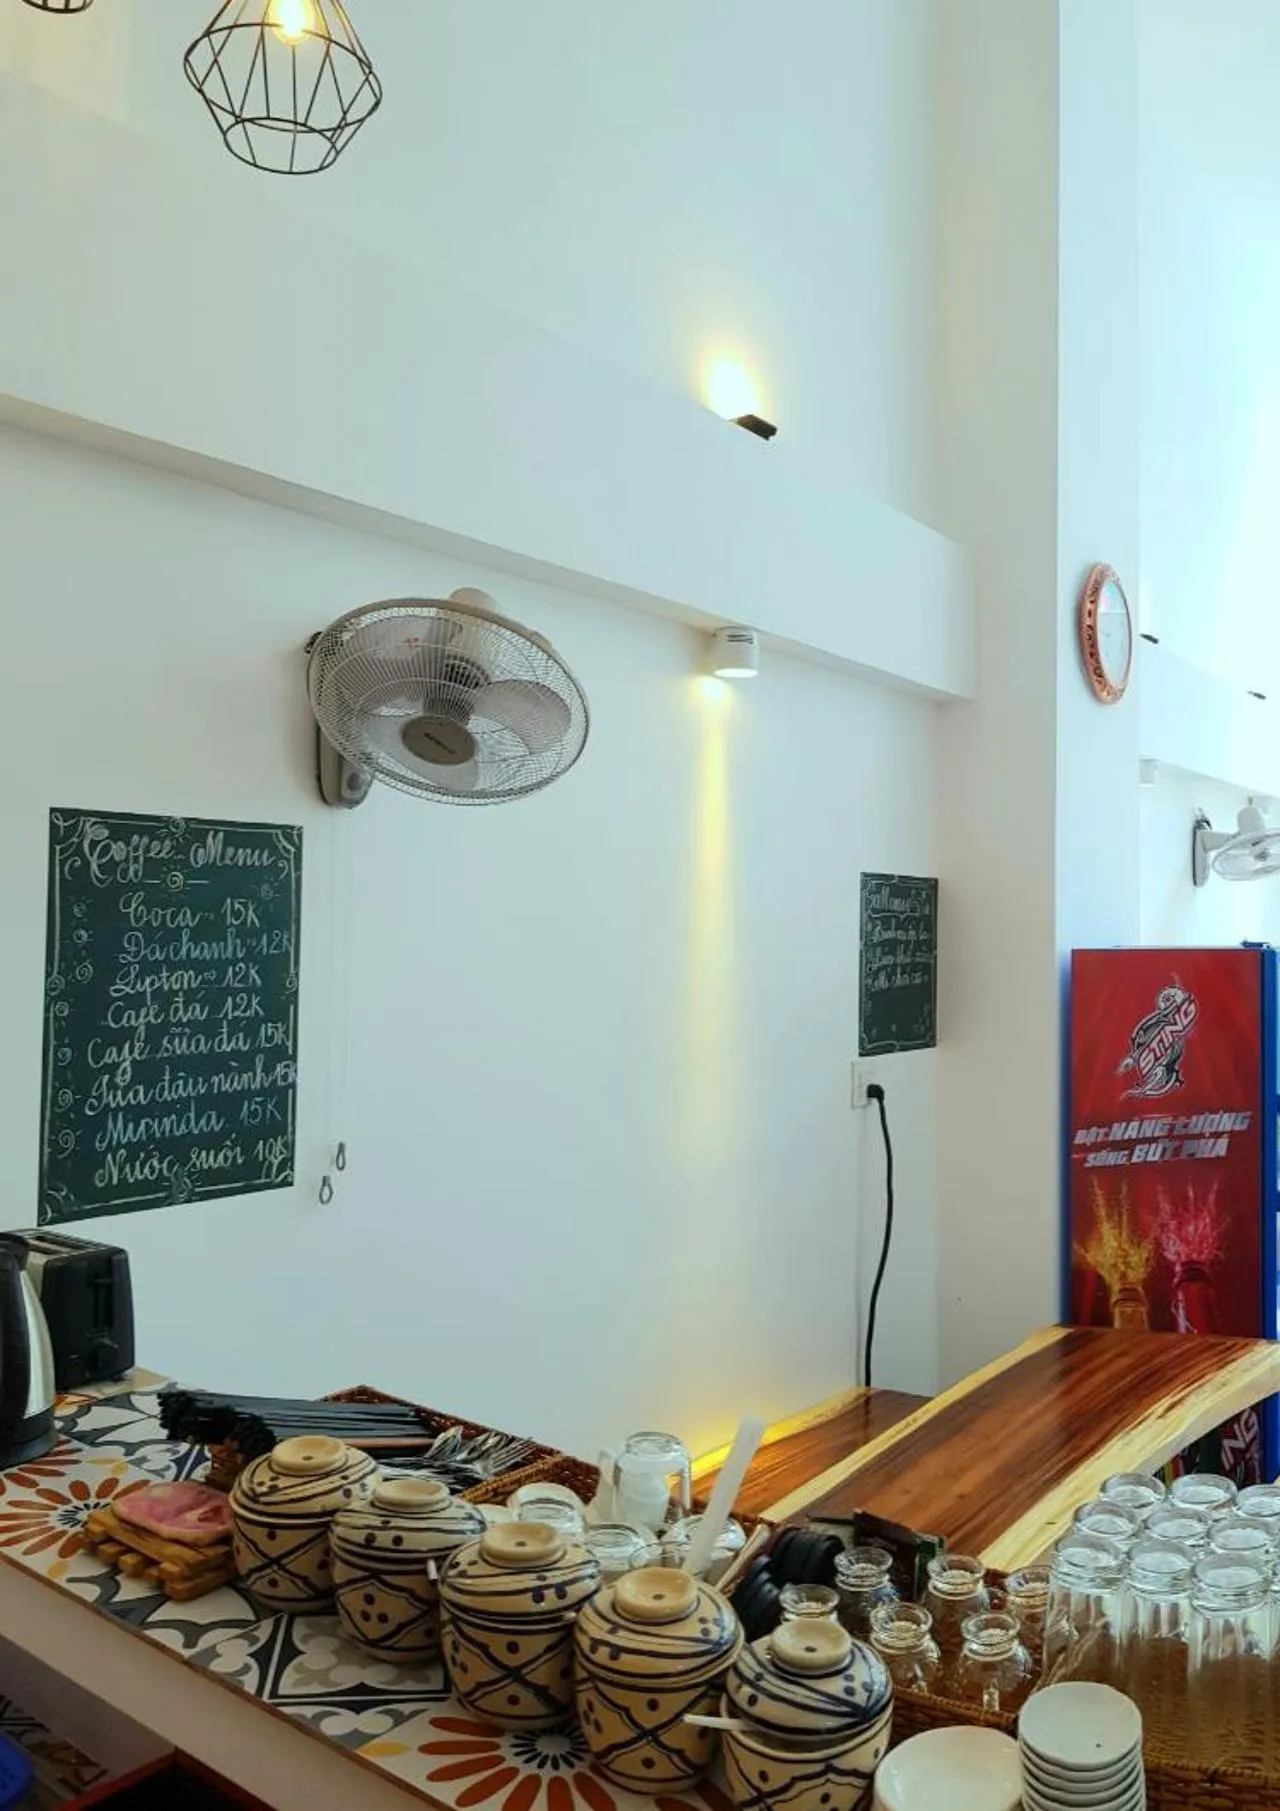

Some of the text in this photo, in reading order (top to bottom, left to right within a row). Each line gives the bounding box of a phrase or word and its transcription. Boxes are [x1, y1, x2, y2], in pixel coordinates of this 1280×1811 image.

[84, 819, 276, 888] Coffee Menu
[120, 892, 260, 928] Coca 15K
[168, 928, 247, 962] chanh
[221, 962, 263, 988] 12K
[219, 992, 265, 1020] 12K
[1139, 998, 1197, 1076] STING
[239, 1096, 282, 1126] 15K
